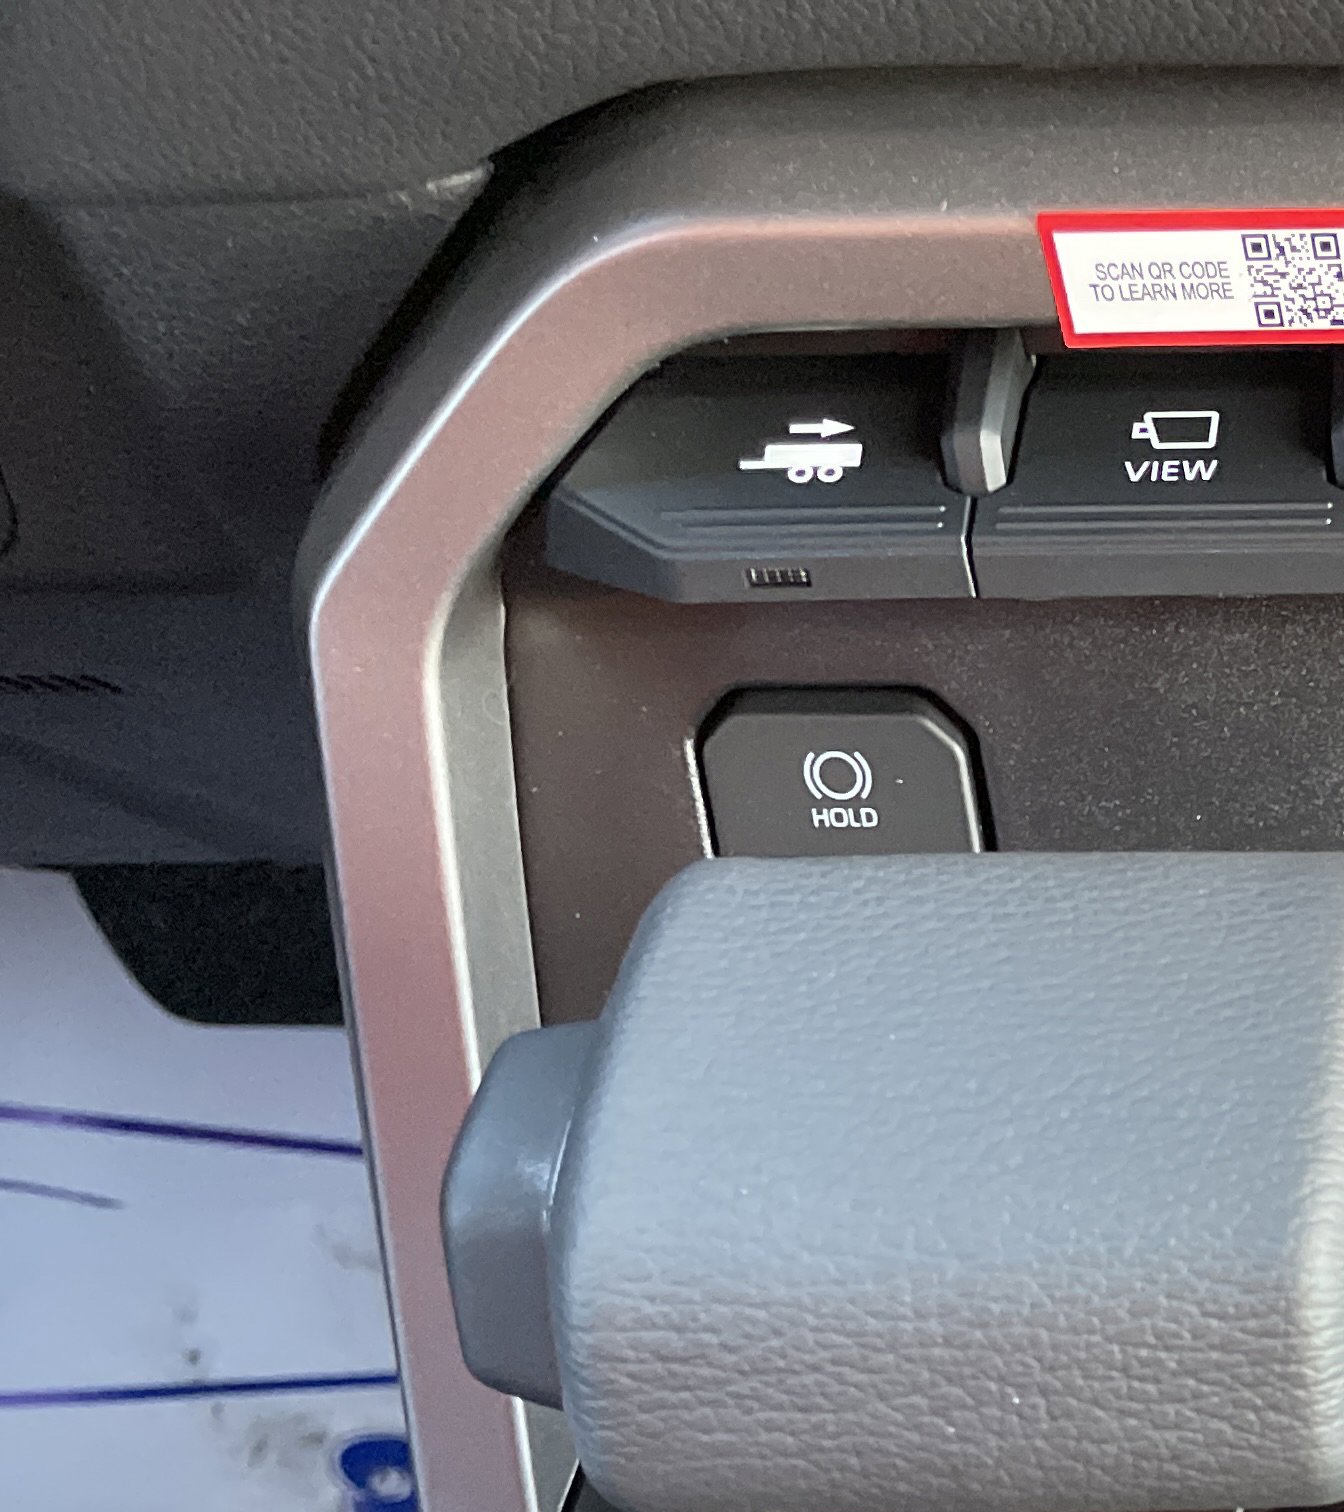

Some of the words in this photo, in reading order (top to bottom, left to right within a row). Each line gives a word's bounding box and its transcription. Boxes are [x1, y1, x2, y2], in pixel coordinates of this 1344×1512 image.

[1094, 262, 1145, 281] SCAN
[1148, 262, 1176, 280] QR
[1179, 261, 1231, 279] CODE
[1089, 284, 1115, 302] TO
[1118, 283, 1177, 301] LEARN
[1181, 282, 1235, 300] MORE
[1124, 459, 1219, 482] VIEW
[810, 807, 879, 828] HOLD
